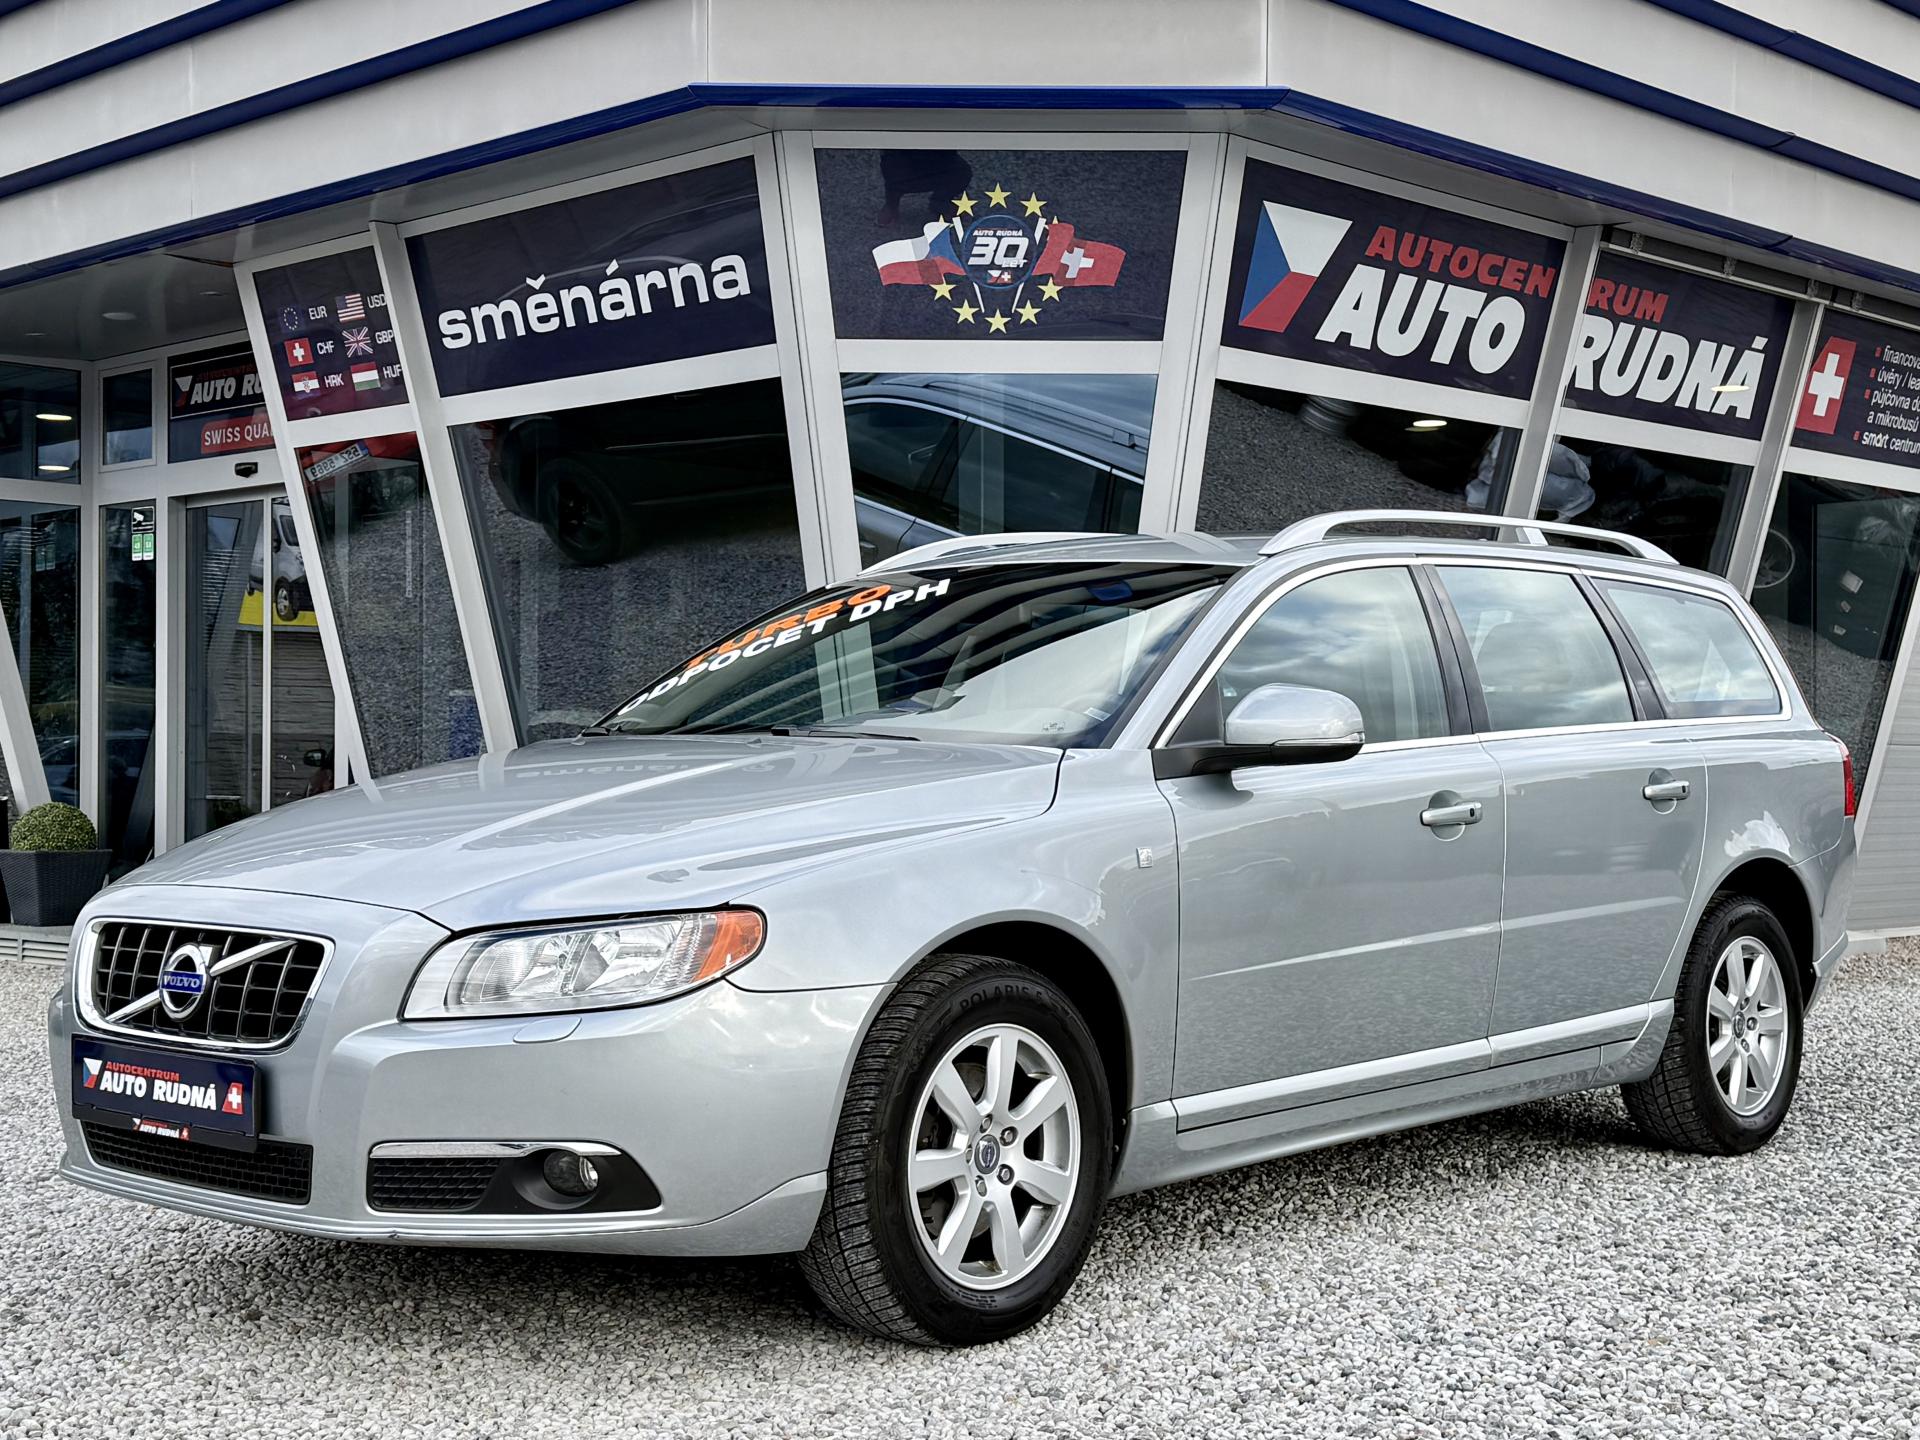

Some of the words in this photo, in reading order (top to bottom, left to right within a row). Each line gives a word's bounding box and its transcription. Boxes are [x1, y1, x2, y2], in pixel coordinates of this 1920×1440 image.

[968, 236, 1029, 265] 30
[367, 293, 386, 309] USD
[438, 254, 751, 349] směnárna
[308, 305, 328, 320] EUR
[375, 329, 394, 345] GBP
[1314, 263, 1526, 374] AUTO
[1567, 314, 1769, 420] RUDNÁ
[316, 340, 335, 355] CHF
[324, 372, 344, 388] HRK
[382, 363, 402, 379] HUF
[1877, 366, 1903, 390] úvěry
[190, 377, 237, 405] AUTO
[1867, 411, 1875, 423] a
[204, 426, 241, 446] SWISS
[244, 422, 273, 442] QUA
[1861, 431, 1890, 449] smart
[682, 584, 892, 669] TURBO
[617, 613, 837, 716] ODPOCET
[849, 578, 951, 622] DPH
[163, 975, 201, 988] VOLVO
[959, 984, 1029, 1012] POLARIS
[105, 1061, 180, 1081] AUTOCENTRUM
[100, 1070, 147, 1098] AUTO
[152, 1079, 217, 1111] RUDNÁ
[139, 1124, 157, 1135] AUTO
[156, 1127, 180, 1139] RUDNÁ
